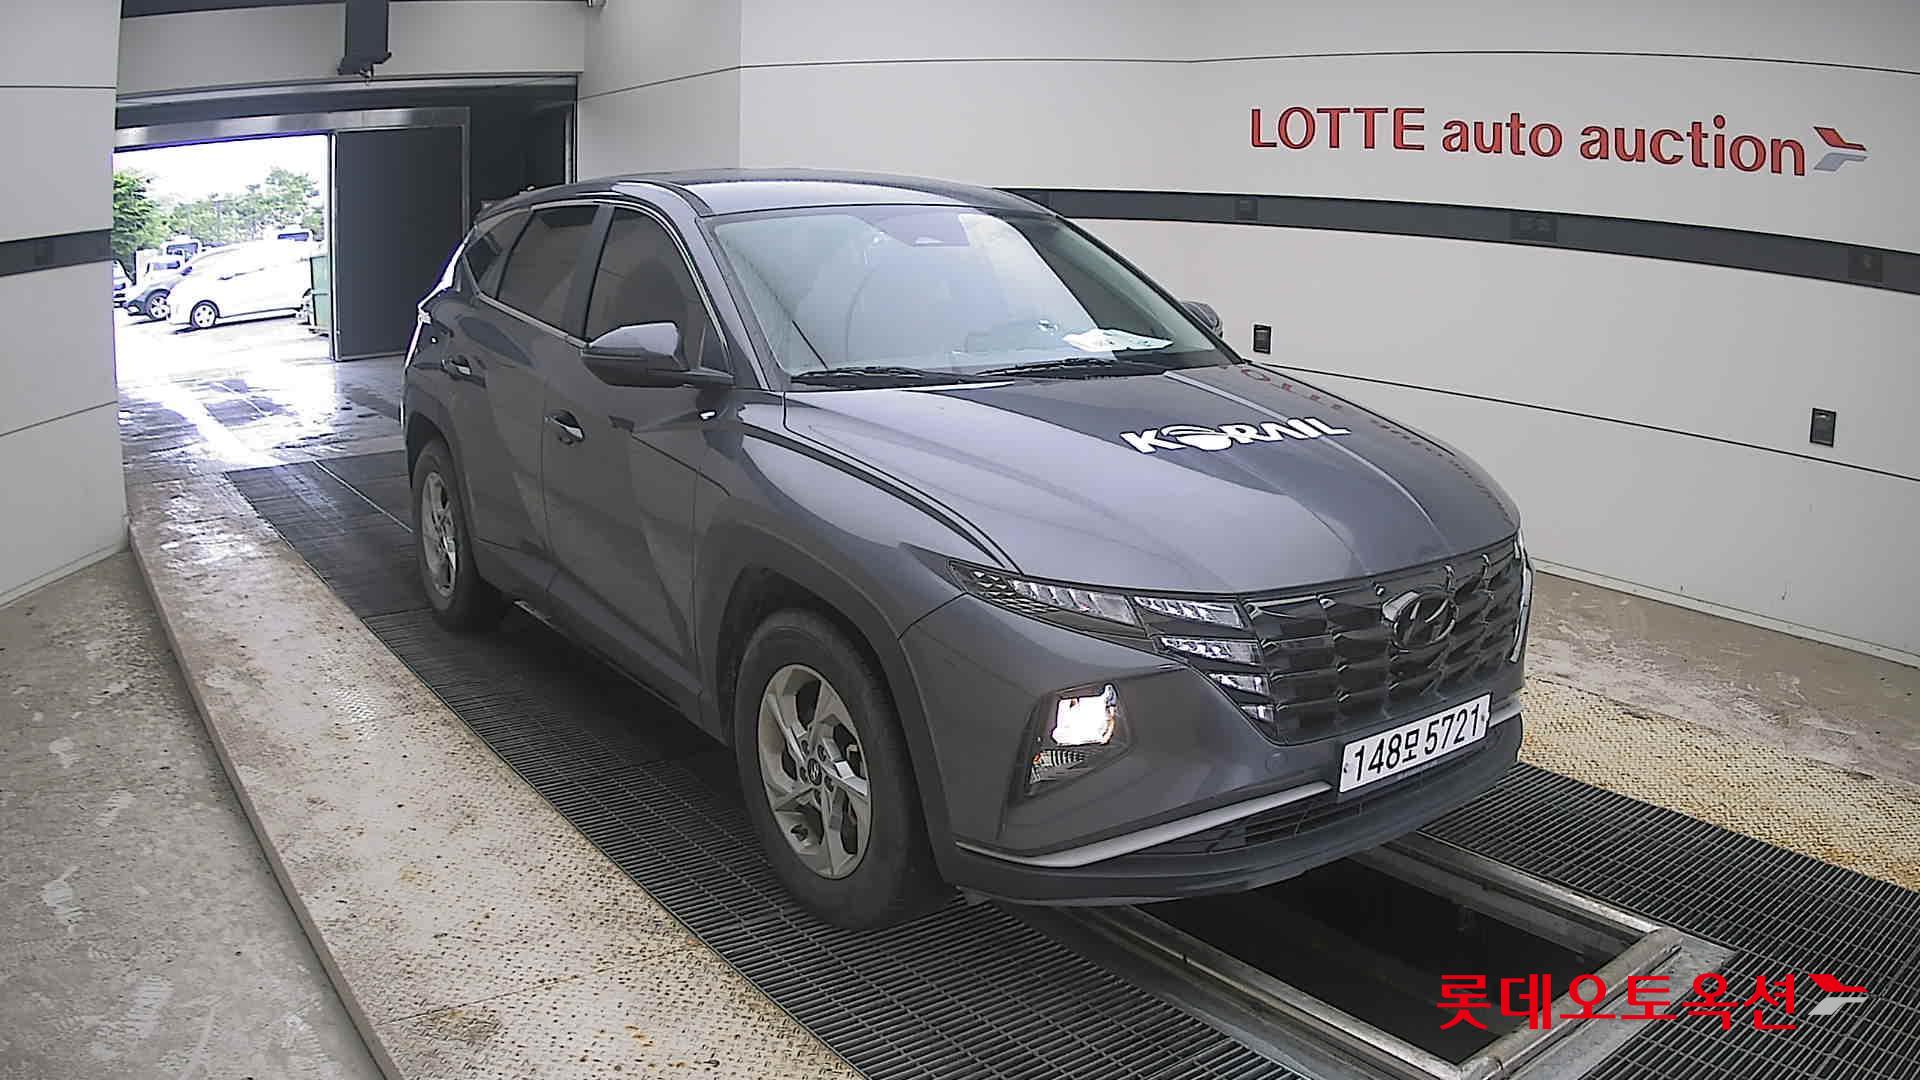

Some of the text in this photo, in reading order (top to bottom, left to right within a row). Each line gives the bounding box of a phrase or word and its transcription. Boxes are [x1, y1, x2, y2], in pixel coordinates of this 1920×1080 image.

[1250, 107, 1806, 176] LOTTE auto auction
[1120, 417, 1351, 454] KORAIL
